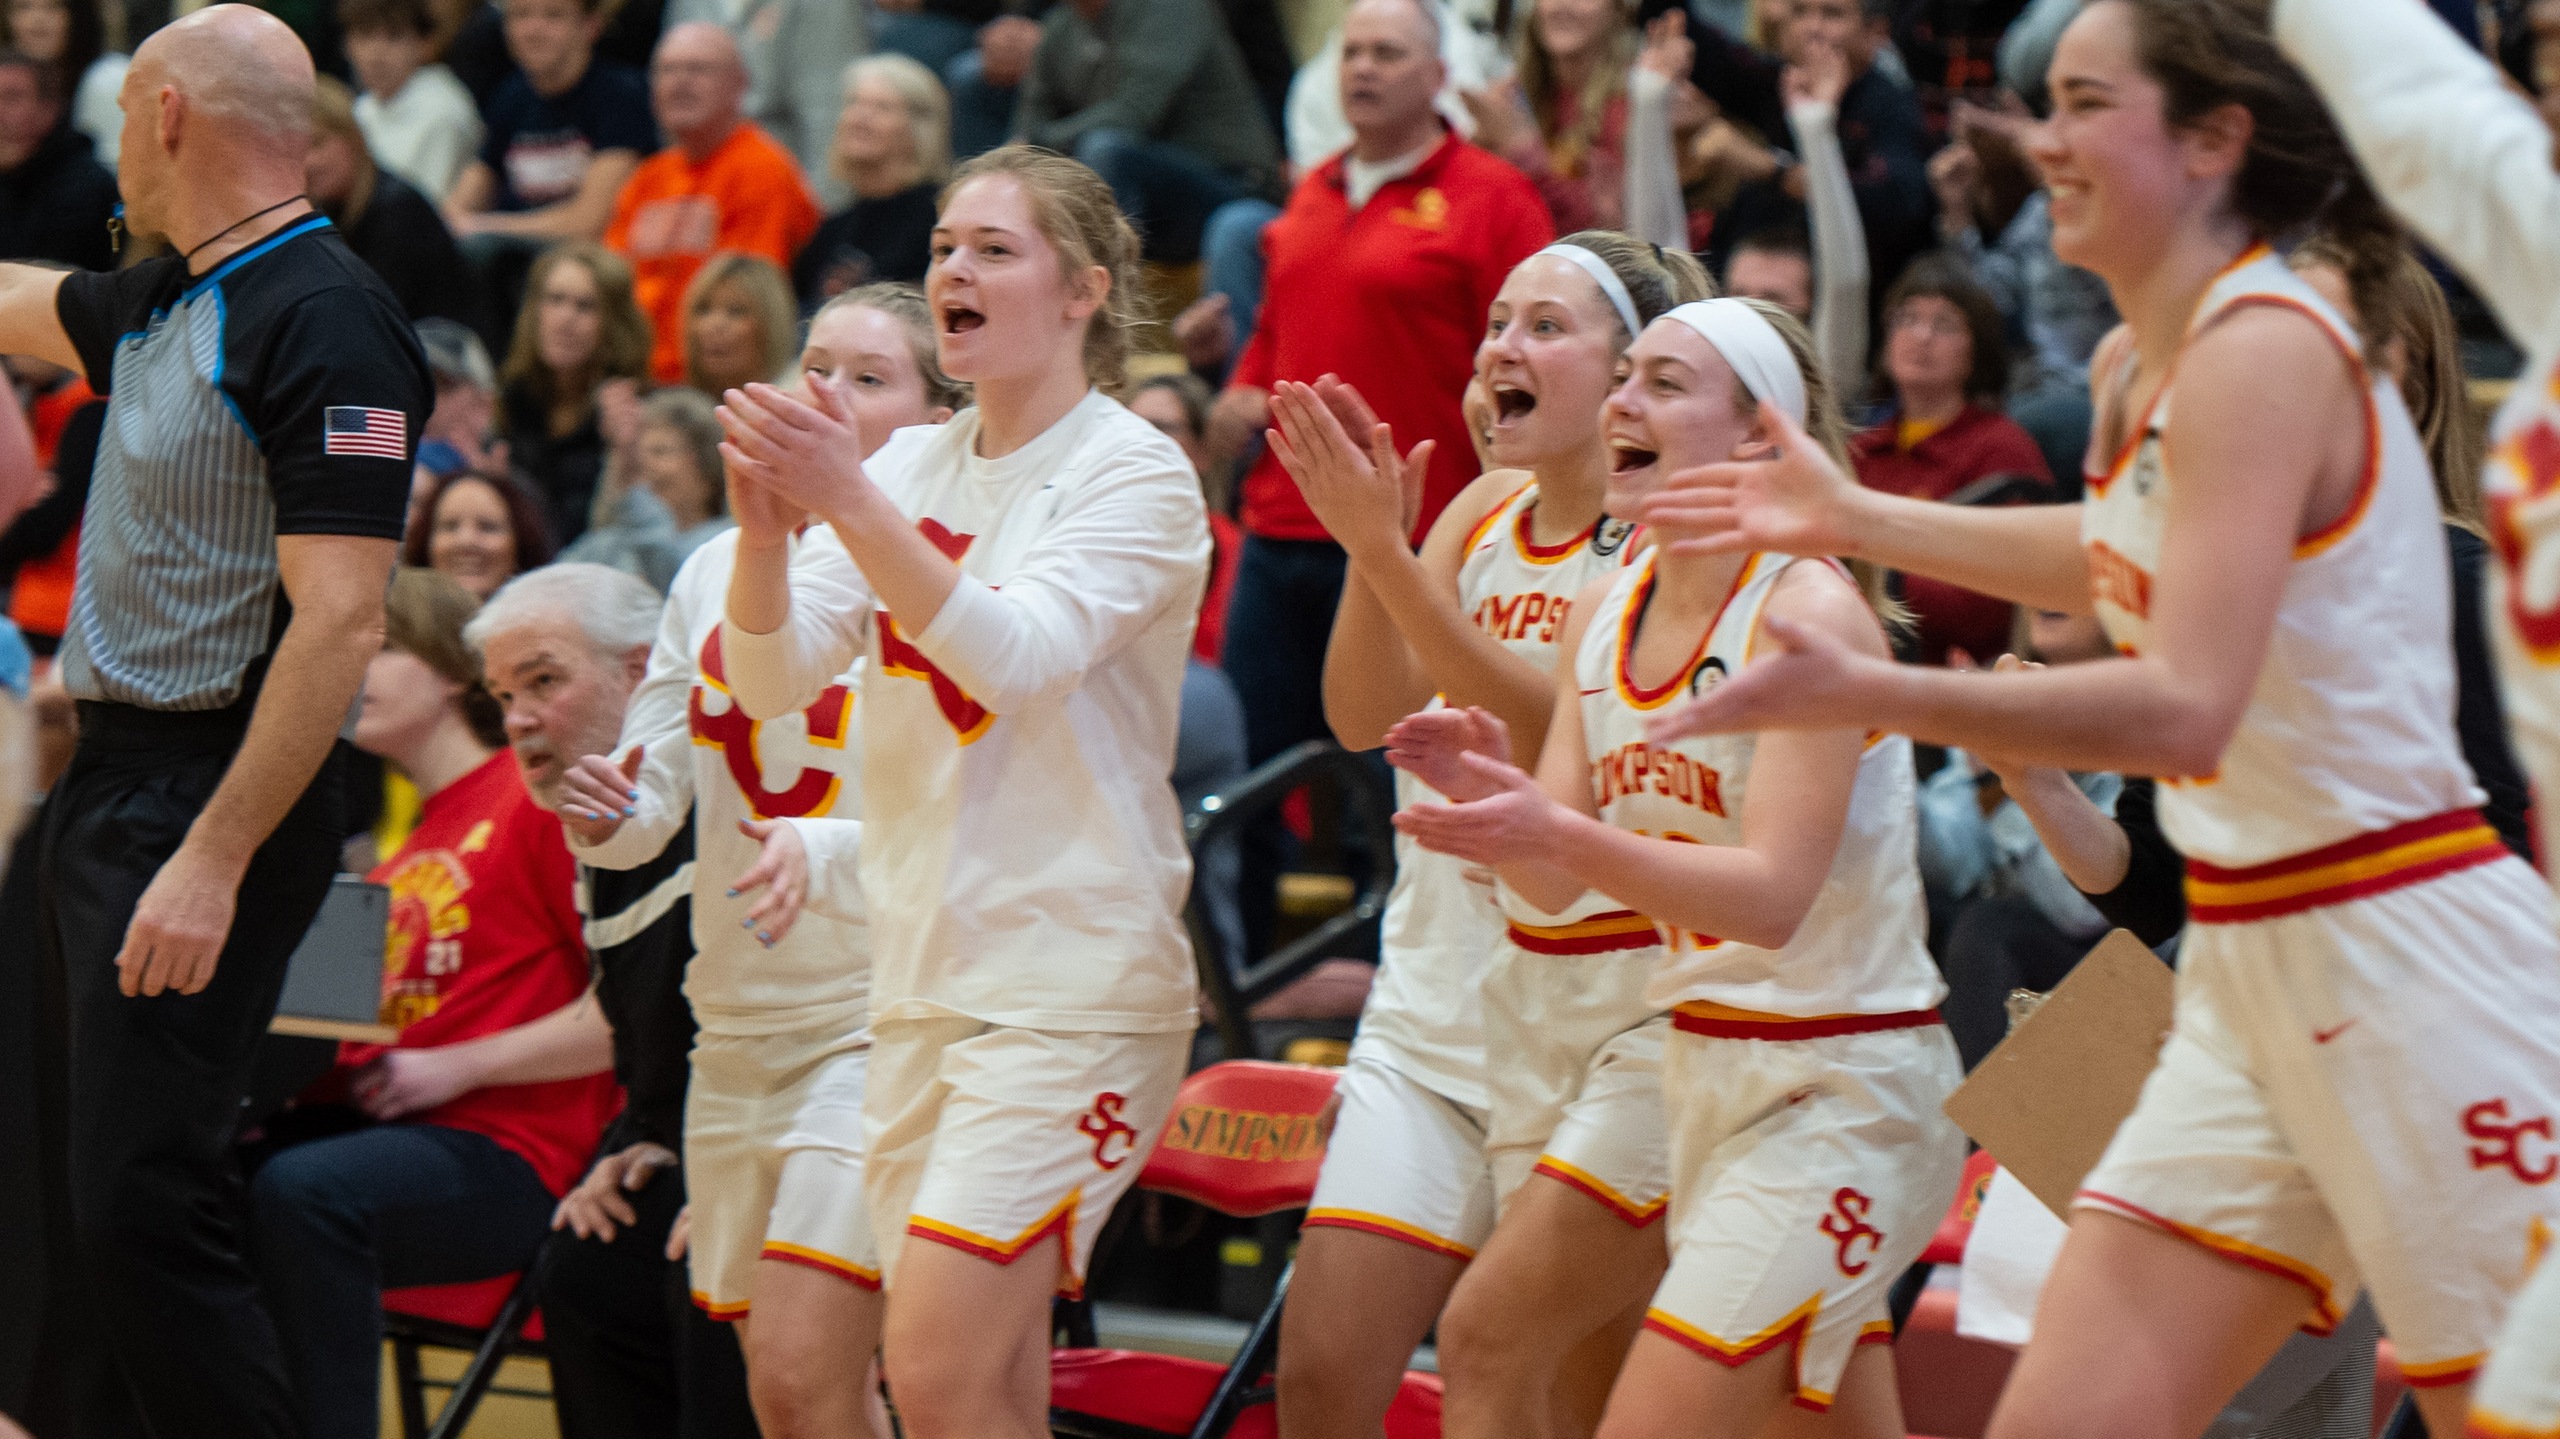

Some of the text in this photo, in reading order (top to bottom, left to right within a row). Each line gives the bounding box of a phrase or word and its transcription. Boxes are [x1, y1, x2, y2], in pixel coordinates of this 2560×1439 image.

[1076, 1090, 1139, 1171] SC
[2459, 1097, 2559, 1186] SC
[1818, 1186, 1887, 1278] SC
